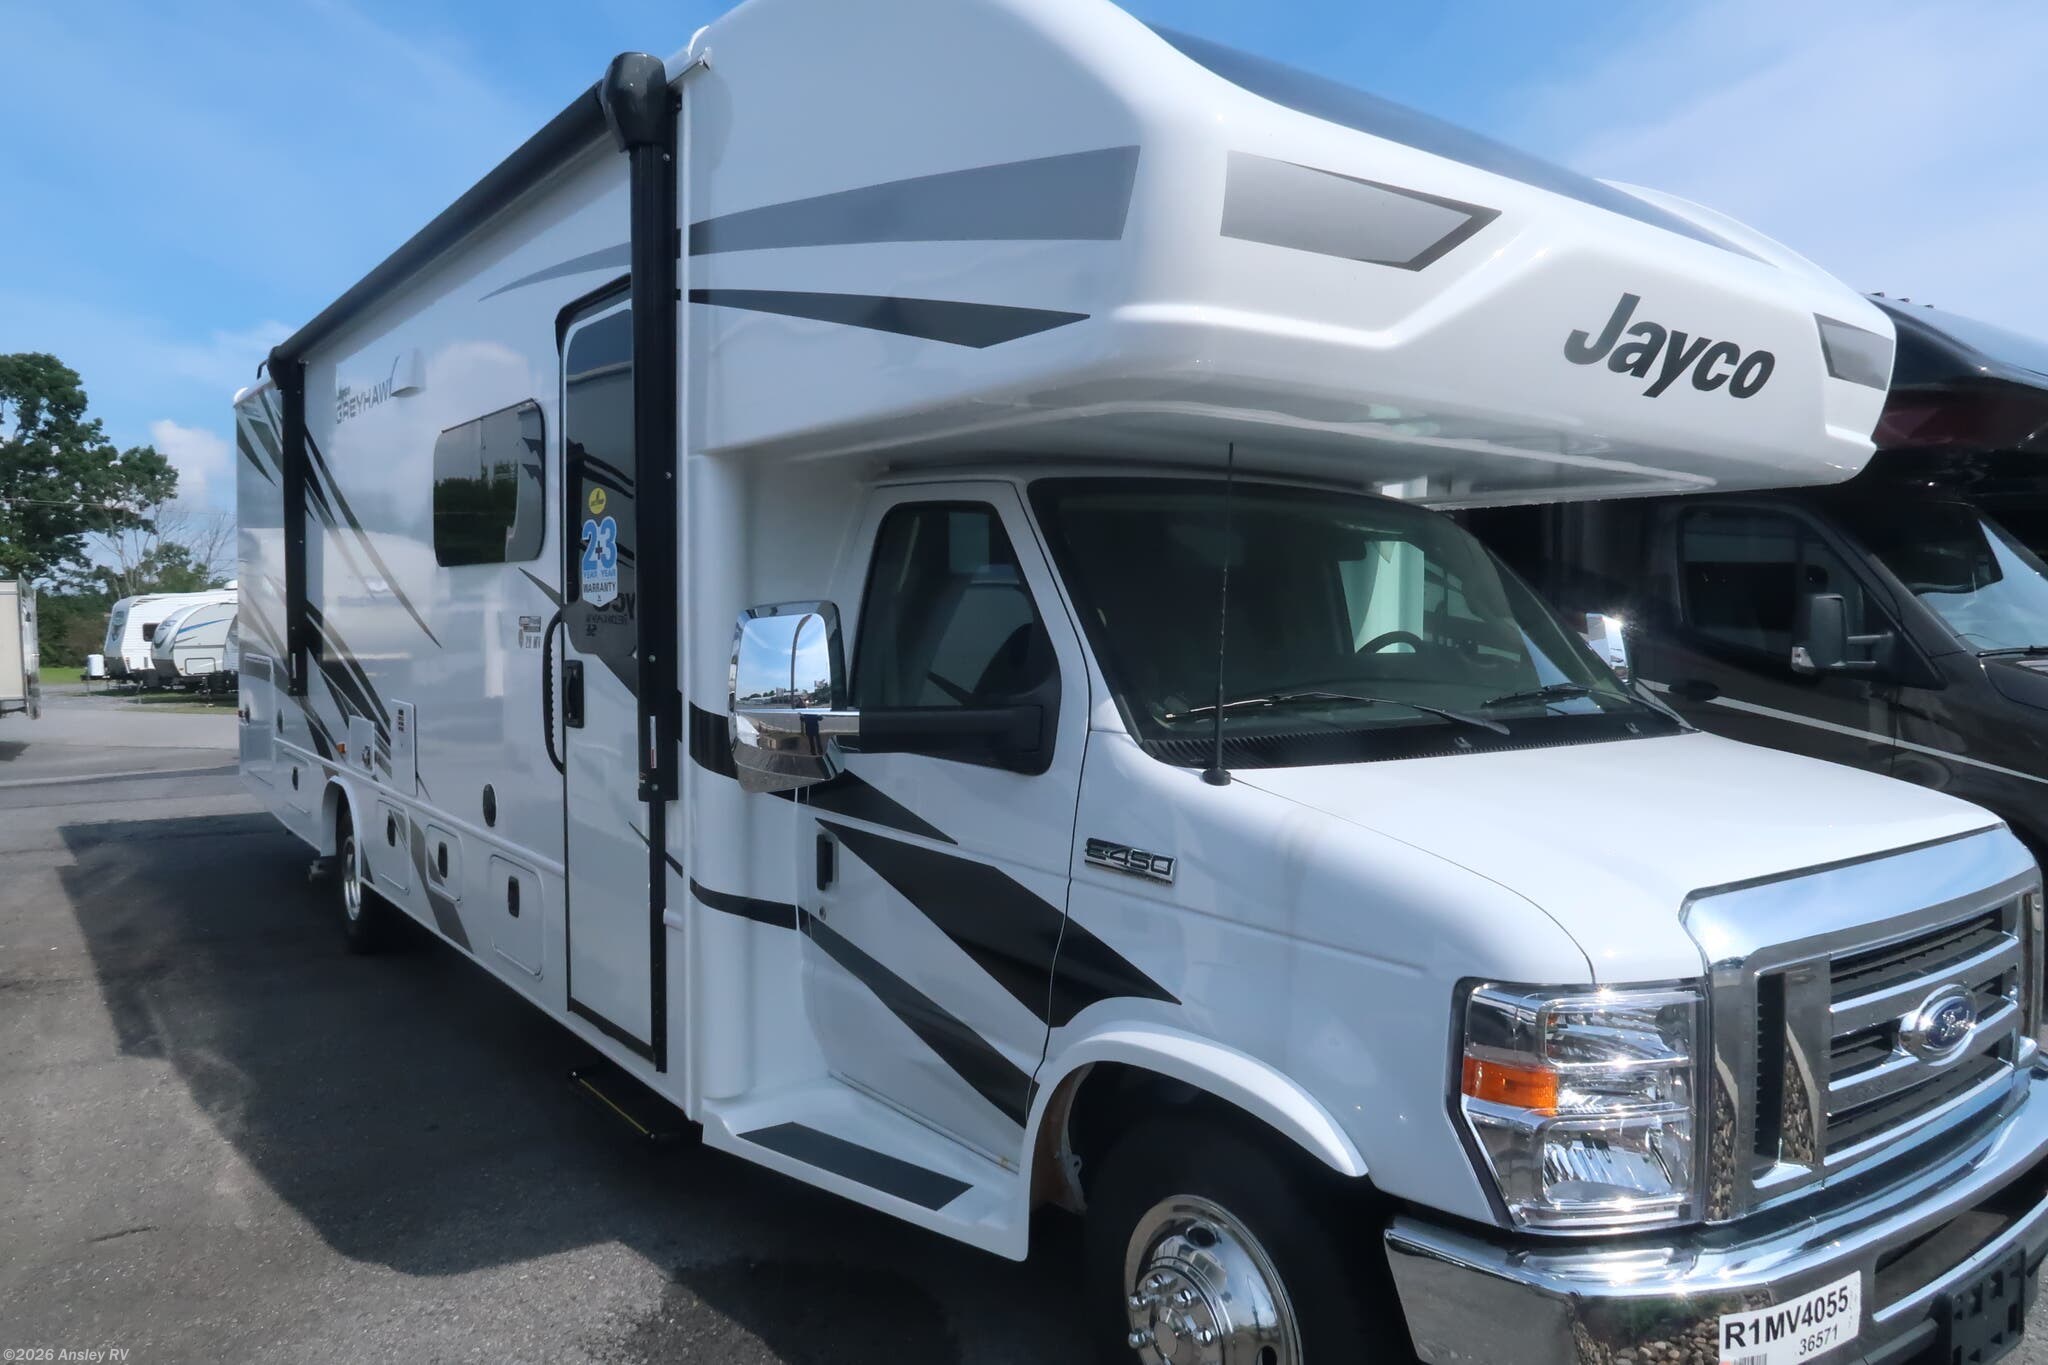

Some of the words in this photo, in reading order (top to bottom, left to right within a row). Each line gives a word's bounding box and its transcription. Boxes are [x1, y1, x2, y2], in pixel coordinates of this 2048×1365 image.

[1564, 292, 1776, 399] Jayco
[584, 582, 616, 593] WARRANTY
[1086, 838, 1176, 880] E-450
[1725, 1285, 1849, 1350] R1MV4055
[1799, 1324, 1838, 1356] 36571
